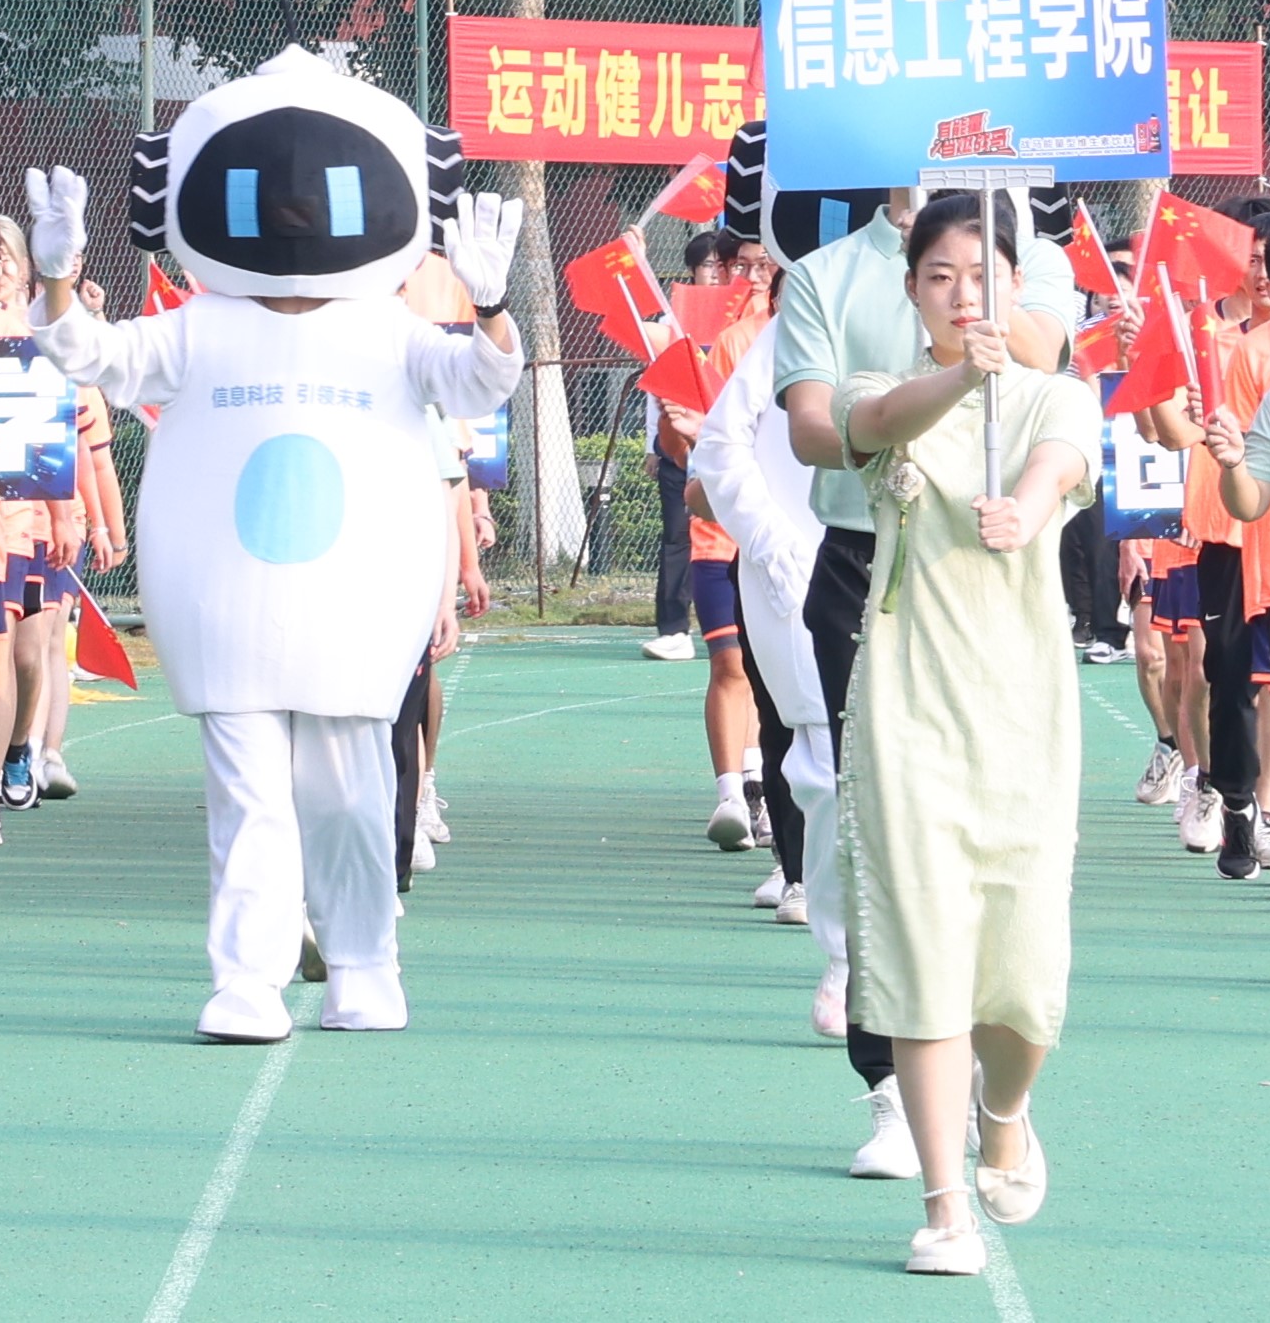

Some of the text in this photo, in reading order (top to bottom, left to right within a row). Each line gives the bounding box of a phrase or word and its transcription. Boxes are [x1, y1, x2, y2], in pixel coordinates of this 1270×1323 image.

[487, 44, 766, 140] 运动健儿志
[211, 382, 374, 411] 信息科技 引领未来
